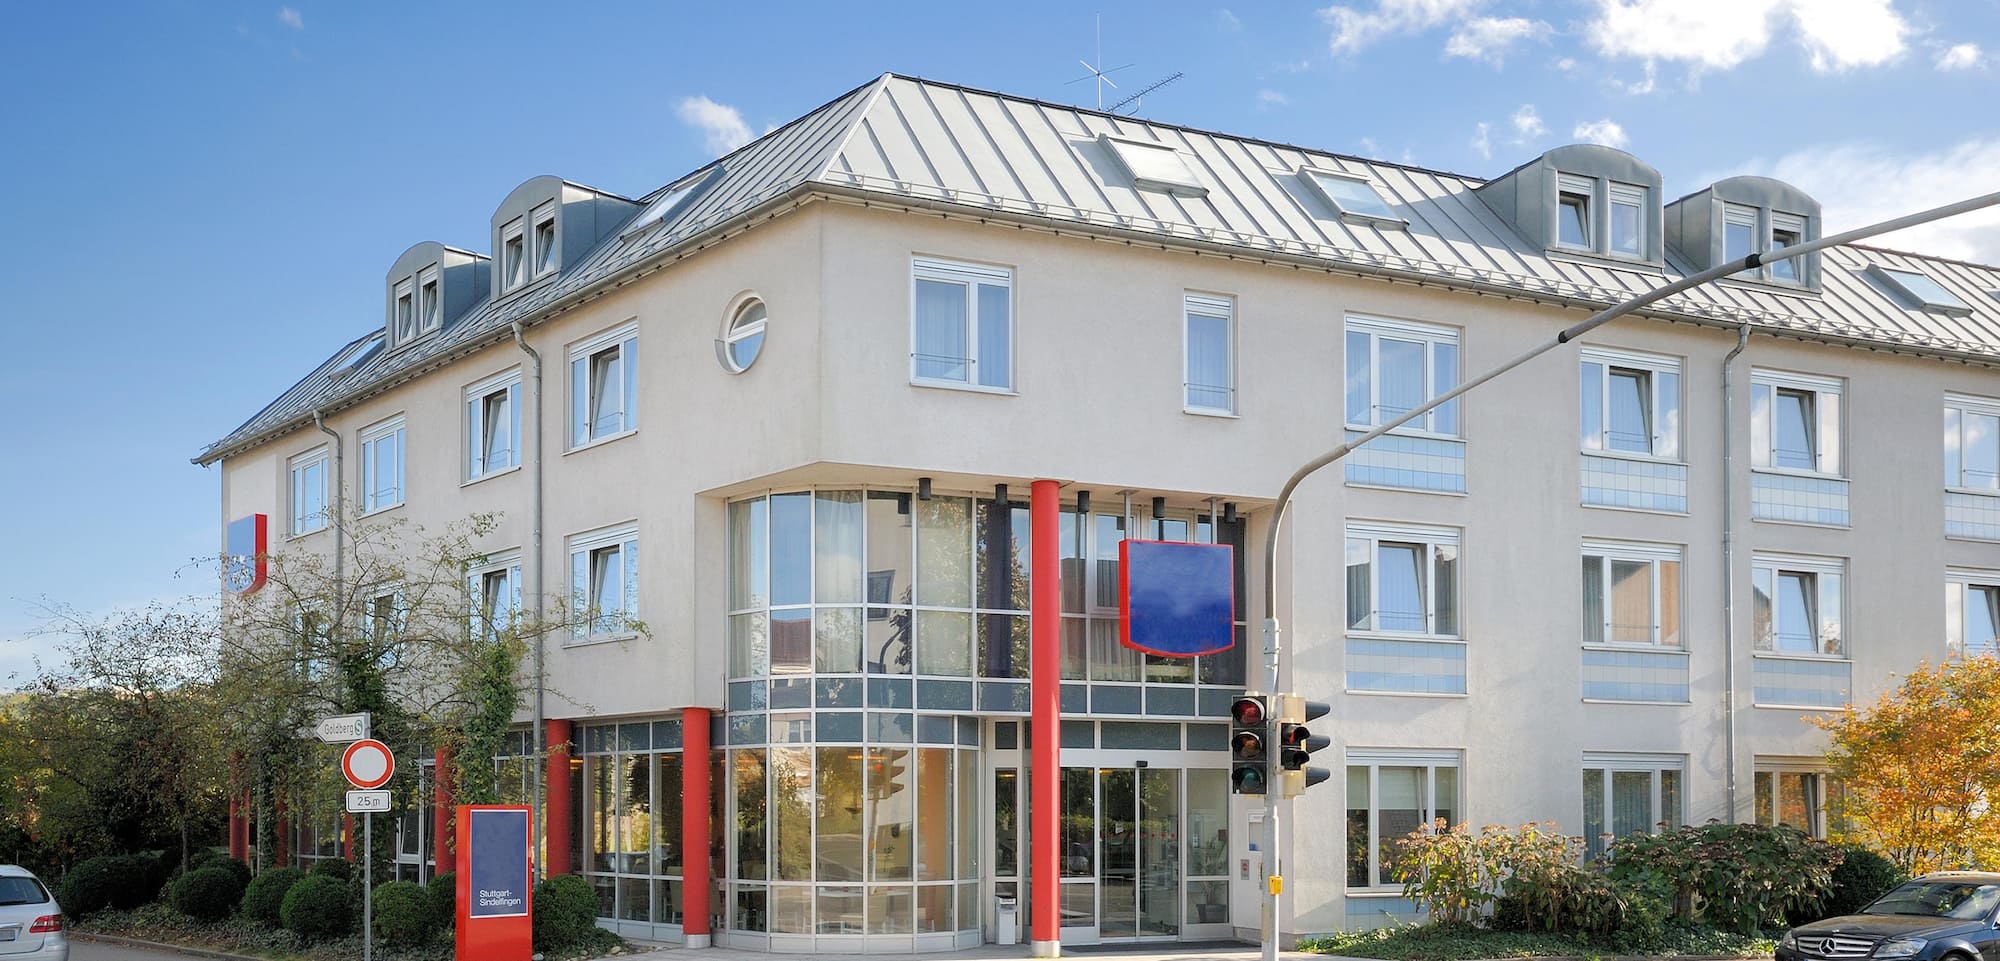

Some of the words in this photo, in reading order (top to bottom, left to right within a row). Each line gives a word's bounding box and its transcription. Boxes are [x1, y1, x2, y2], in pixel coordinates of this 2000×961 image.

[325, 723, 354, 736] Goldberg
[357, 796, 371, 807] 25
[372, 798, 380, 807] m
[479, 889, 512, 899] Stuttgart-
[479, 898, 521, 906] Sindelfingen
